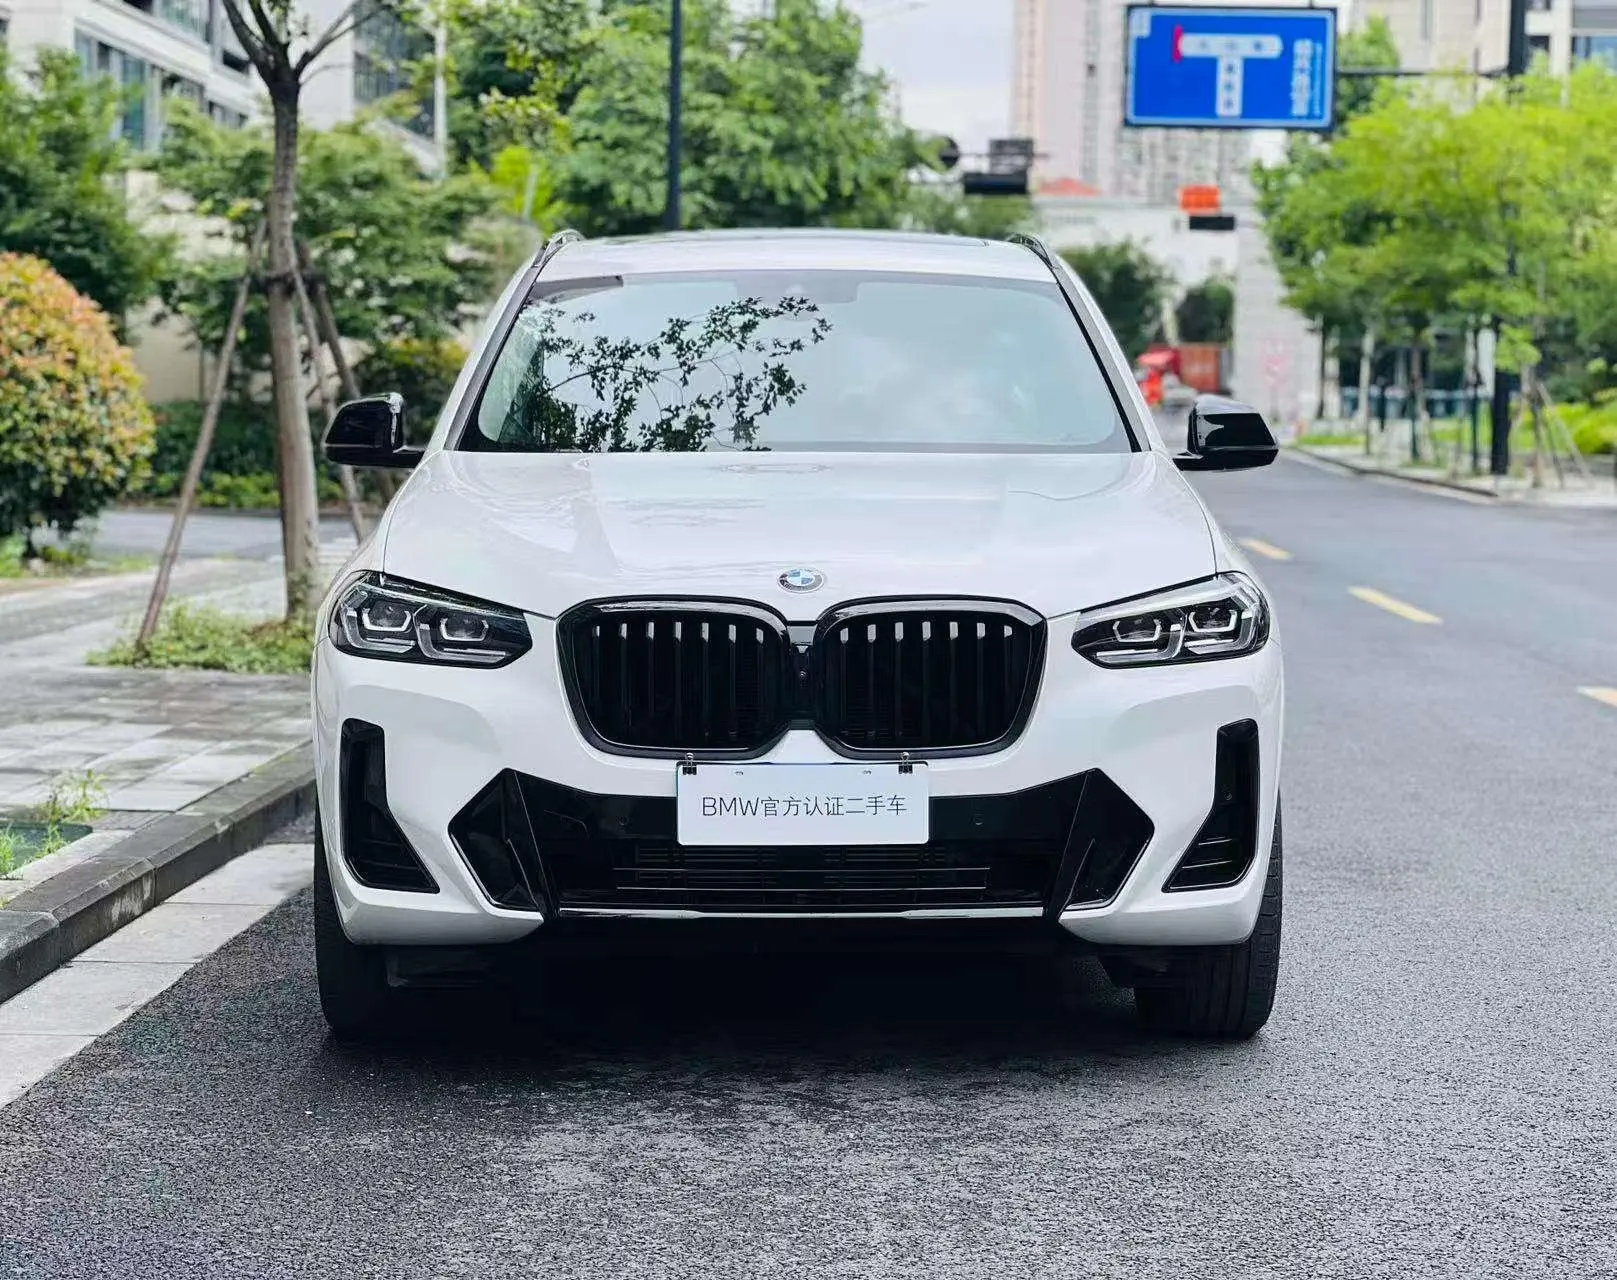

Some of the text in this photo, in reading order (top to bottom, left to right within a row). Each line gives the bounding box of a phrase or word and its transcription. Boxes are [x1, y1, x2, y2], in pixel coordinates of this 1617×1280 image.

[702, 794, 908, 817] BMW官方认证二手车
